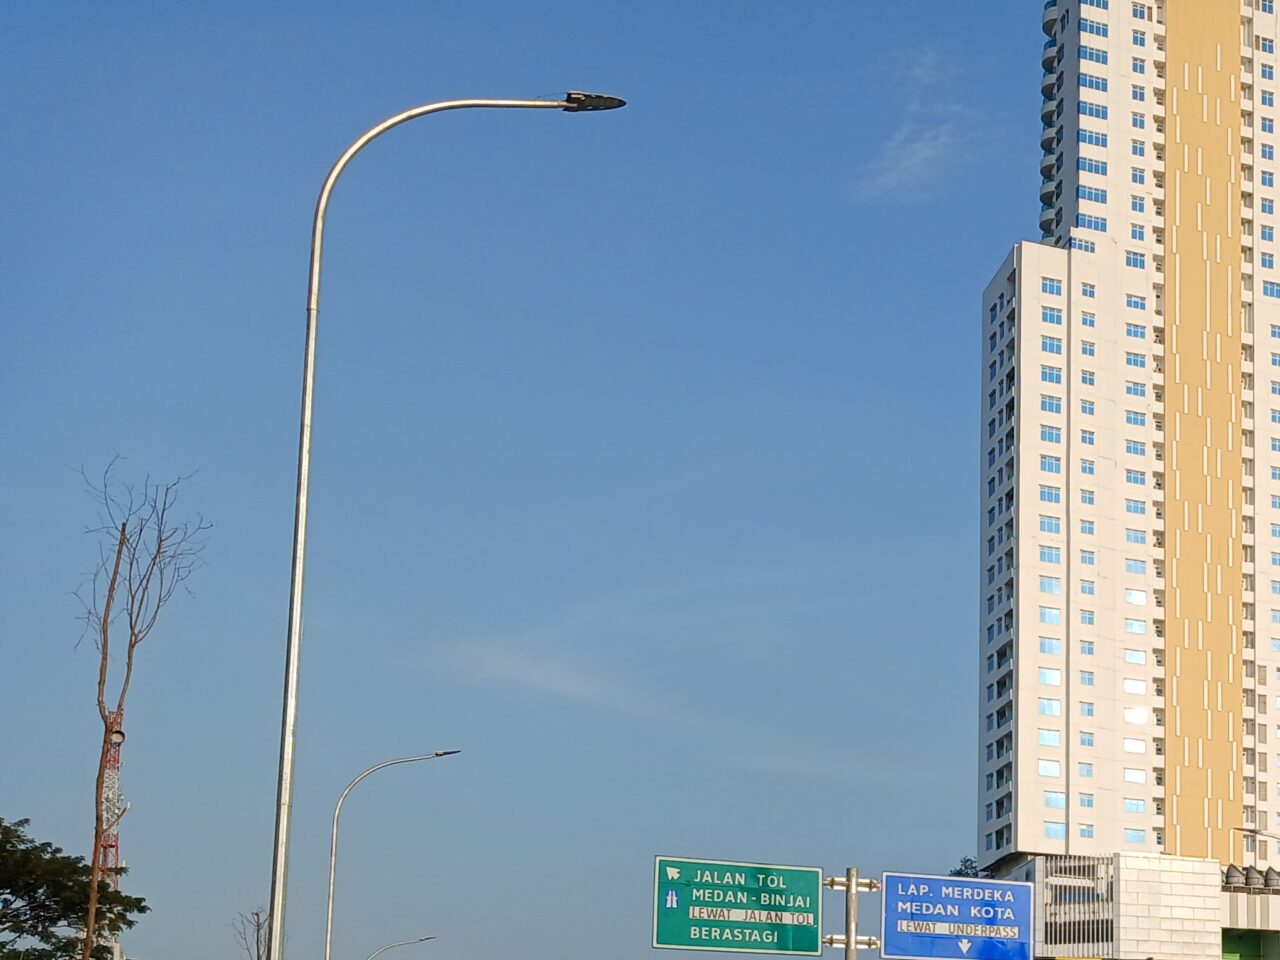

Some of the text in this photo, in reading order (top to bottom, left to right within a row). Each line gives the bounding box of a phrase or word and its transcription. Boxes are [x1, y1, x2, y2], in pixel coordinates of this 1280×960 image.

[694, 870, 787, 888] JALAN TOL
[898, 883, 1015, 902] LAP. MERDEKA
[691, 907, 812, 925] LEWAT JALAN TOL
[897, 901, 1015, 920] MEDAN KOTA
[690, 926, 778, 943] BERASTAGI
[899, 920, 1017, 938] LEWAT UNDERPASS
